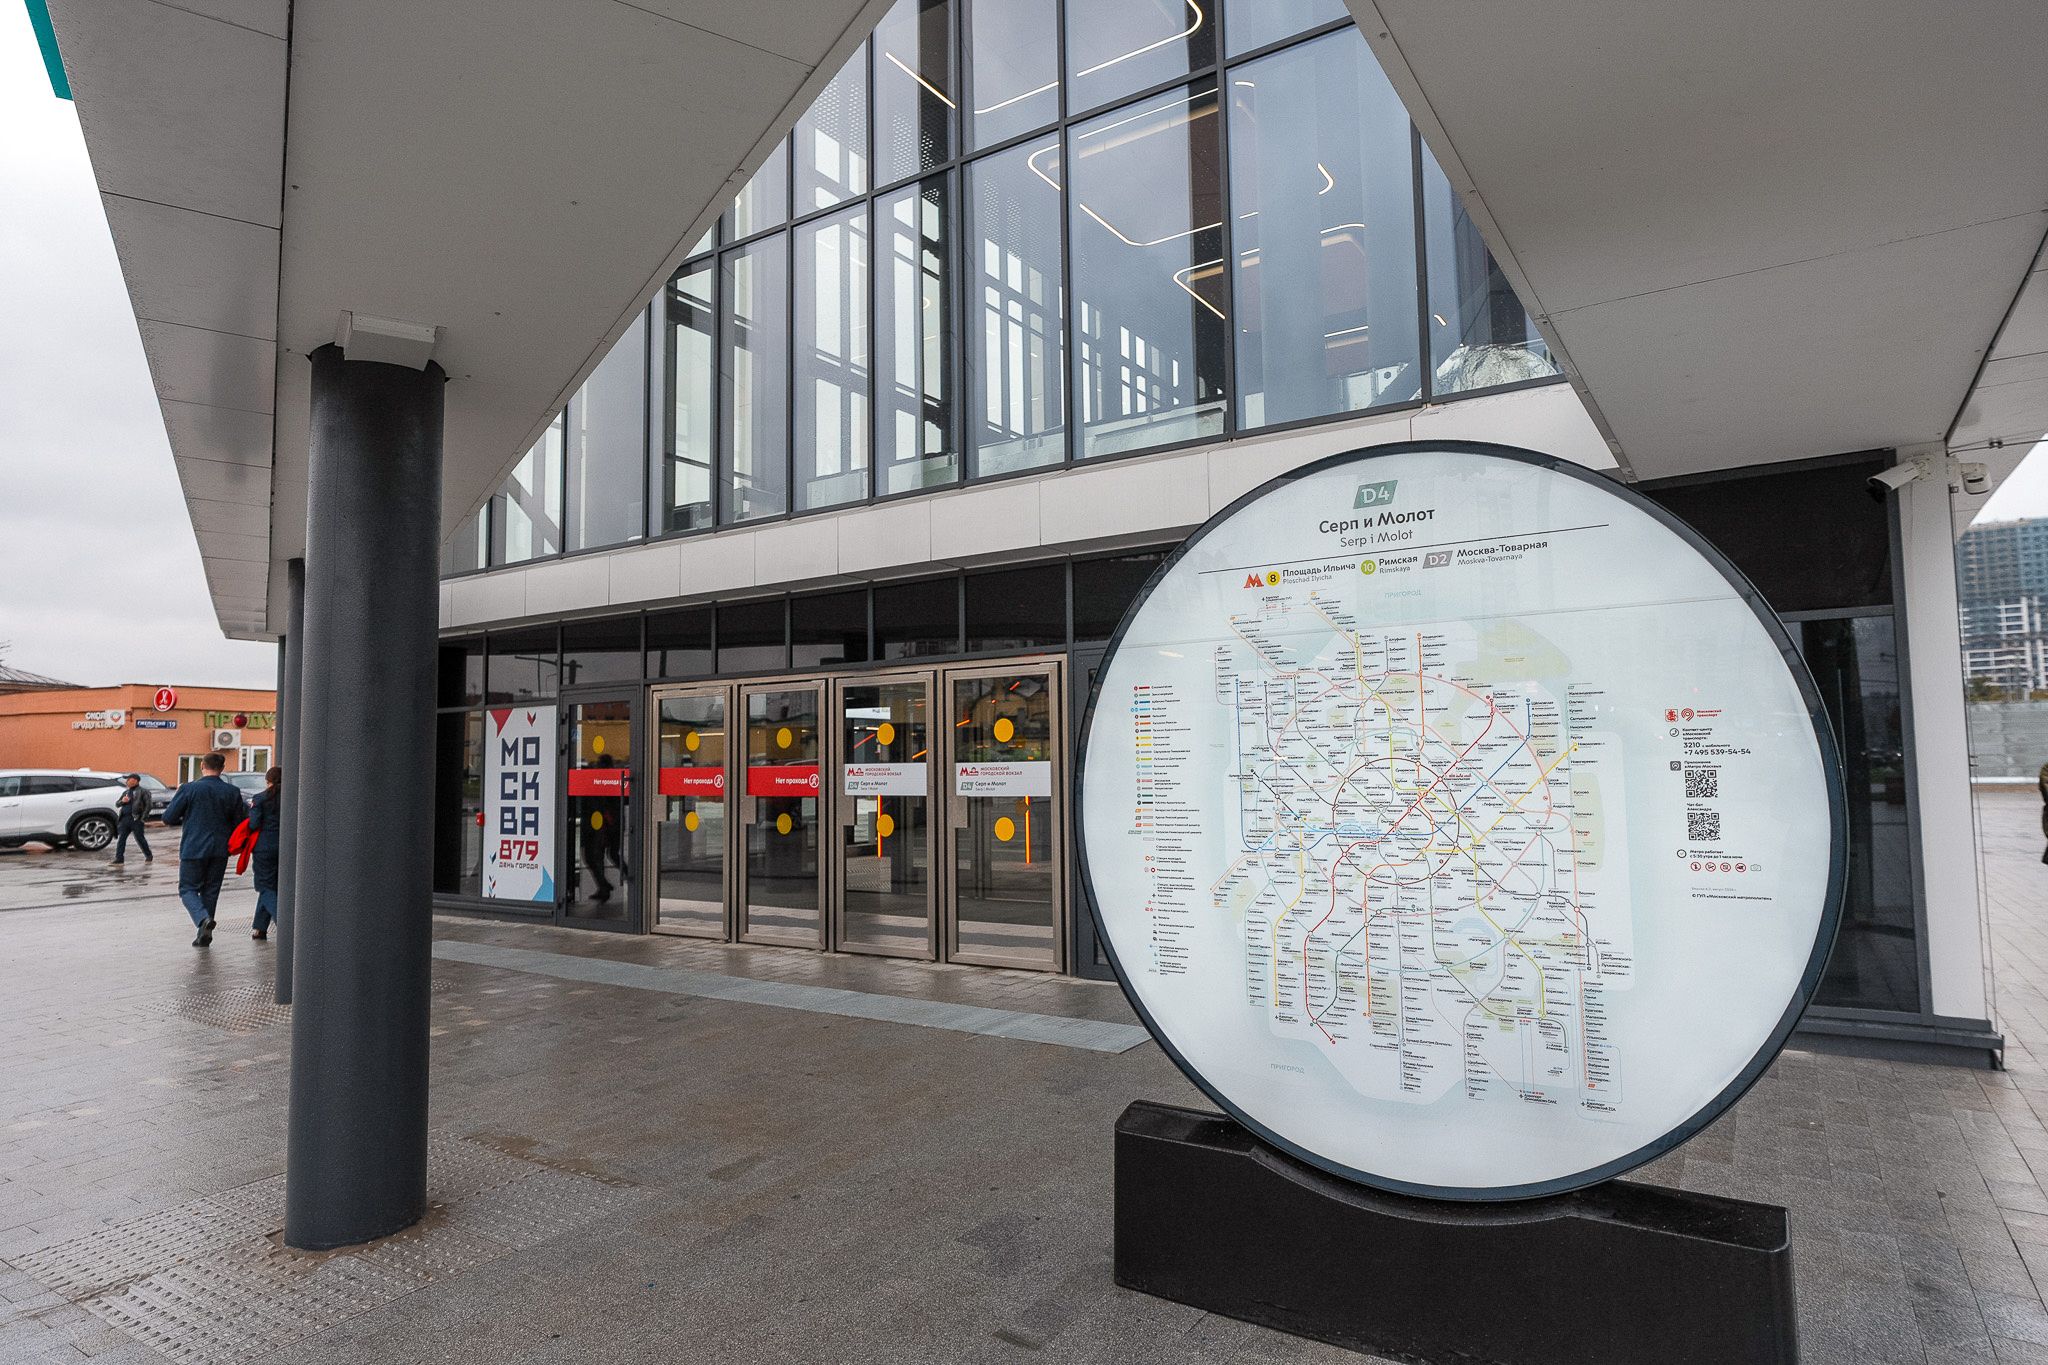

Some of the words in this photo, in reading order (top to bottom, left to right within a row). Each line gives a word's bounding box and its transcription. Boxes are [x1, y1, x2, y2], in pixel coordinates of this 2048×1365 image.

[1362, 486, 1390, 504] D4
[1319, 520, 1358, 534] Серп
[1364, 518, 1373, 528] и
[1378, 509, 1435, 527] Молот
[1340, 537, 1367, 547] Serp
[1370, 534, 1374, 543] i
[1377, 530, 1413, 543] Molot
[1456, 541, 1548, 558] Москва-Товарная
[1428, 554, 1448, 566] D2
[1457, 553, 1523, 567] Moskva-Tovarnaya
[1269, 574, 1277, 583] 8
[1282, 568, 1322, 578] Площадь
[1323, 563, 1356, 572] Ильича
[1363, 563, 1374, 572] 10
[1379, 556, 1418, 566] Римская
[1379, 566, 1411, 574] Rimskaya
[1283, 576, 1310, 585] Ploschad
[1311, 574, 1332, 583] Ilyicha
[1384, 589, 1422, 599] ПРИГОРОД
[500, 840, 539, 861] 879
[1271, 1063, 1304, 1074] ПРИГОРОД
